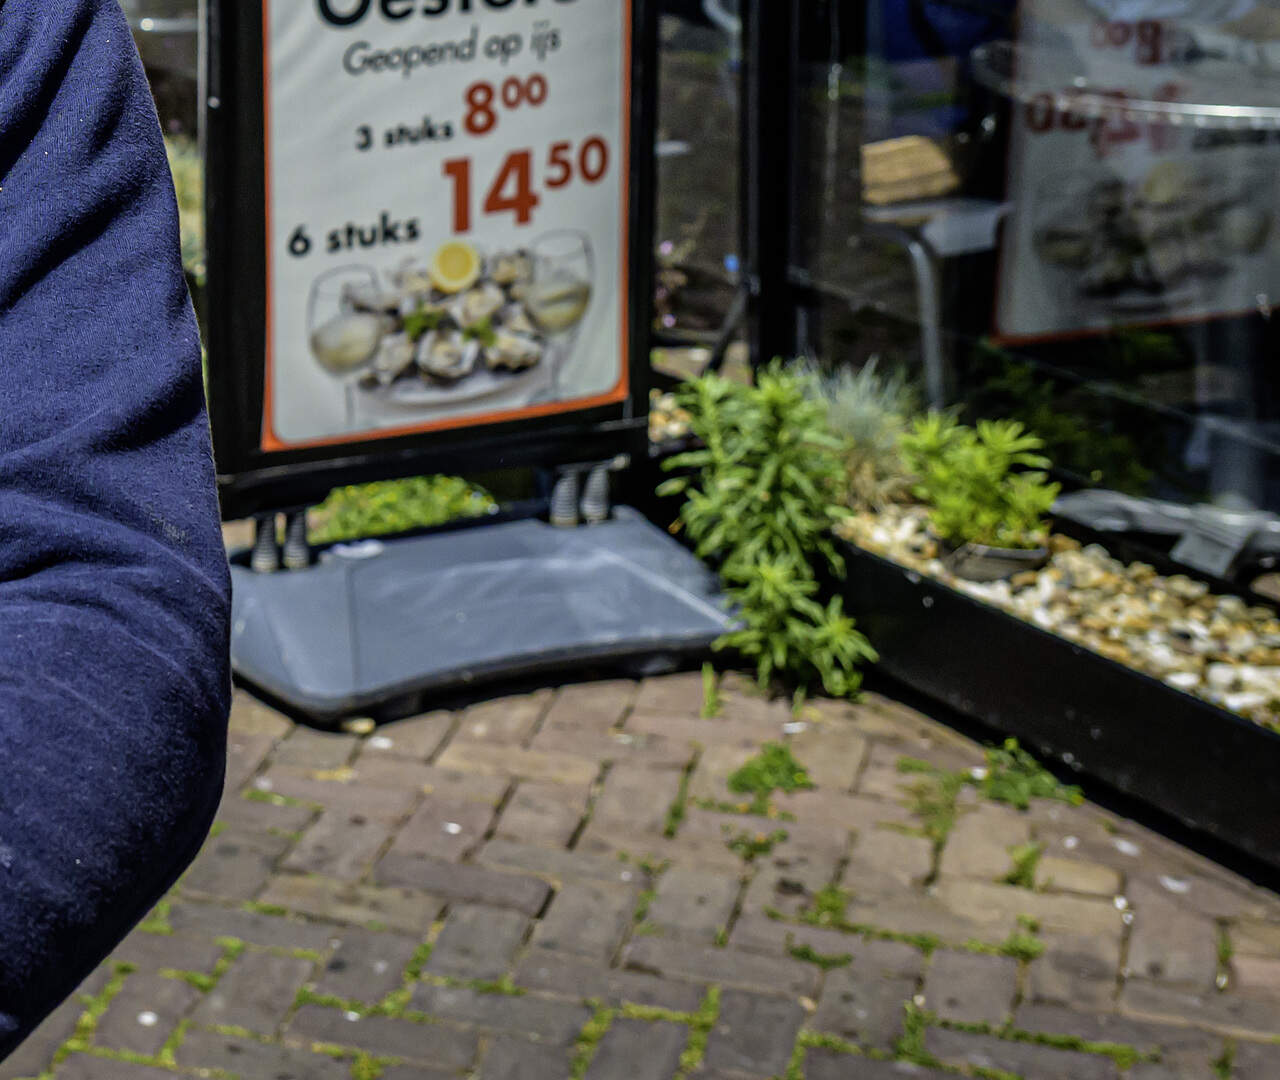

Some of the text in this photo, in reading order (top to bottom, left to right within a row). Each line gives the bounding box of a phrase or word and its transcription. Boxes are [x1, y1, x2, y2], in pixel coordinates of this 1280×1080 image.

[342, 20, 561, 80] Geopend op ijs
[356, 125, 372, 152] 3
[384, 115, 455, 148] stuks
[288, 223, 312, 257] 6
[326, 210, 421, 253] stuks
